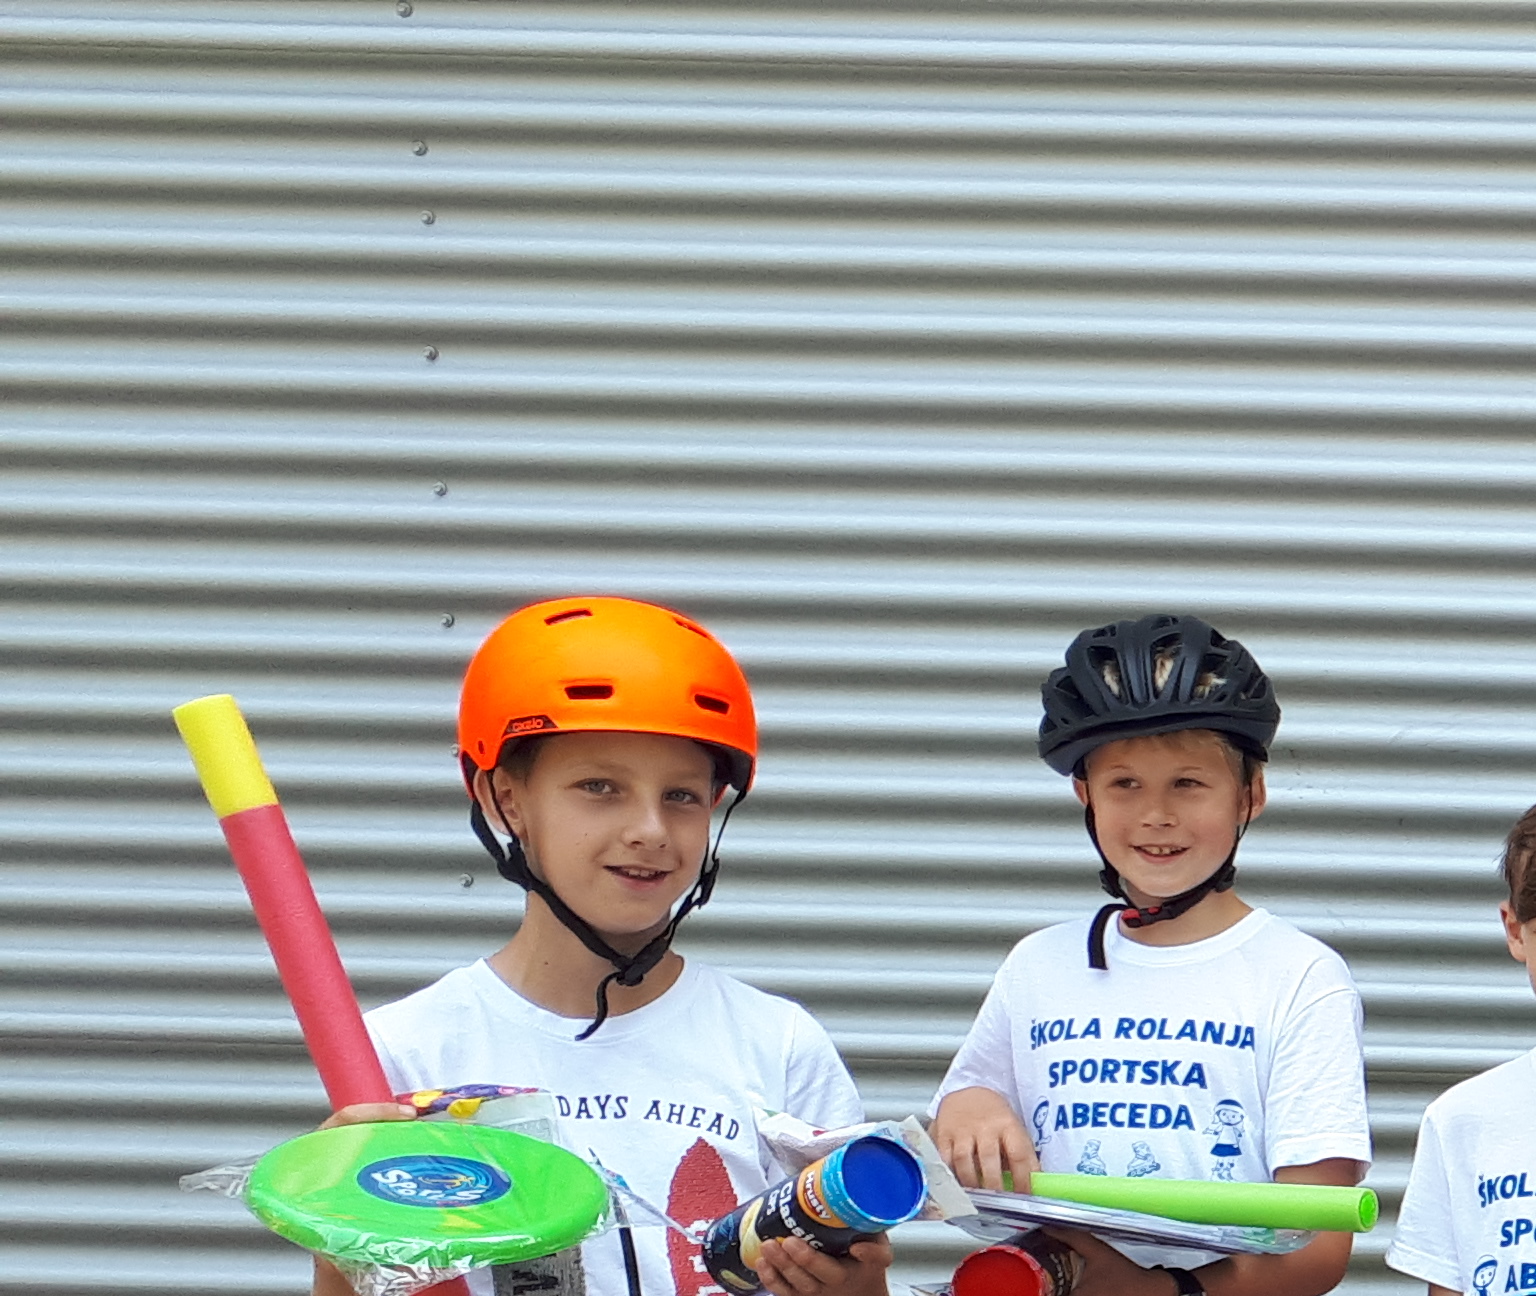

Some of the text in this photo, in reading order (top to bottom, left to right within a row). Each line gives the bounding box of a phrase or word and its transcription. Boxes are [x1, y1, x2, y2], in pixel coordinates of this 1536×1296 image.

[1030, 1017, 1256, 1050] ŠKOLA ROLANJA
[1048, 1058, 1208, 1090] SPORTSKA
[555, 1094, 740, 1140] DAYS AHEAD
[1053, 1101, 1196, 1131] ABECEDA
[804, 1171, 832, 1220] Hrusty
[779, 1181, 824, 1250] Classic
